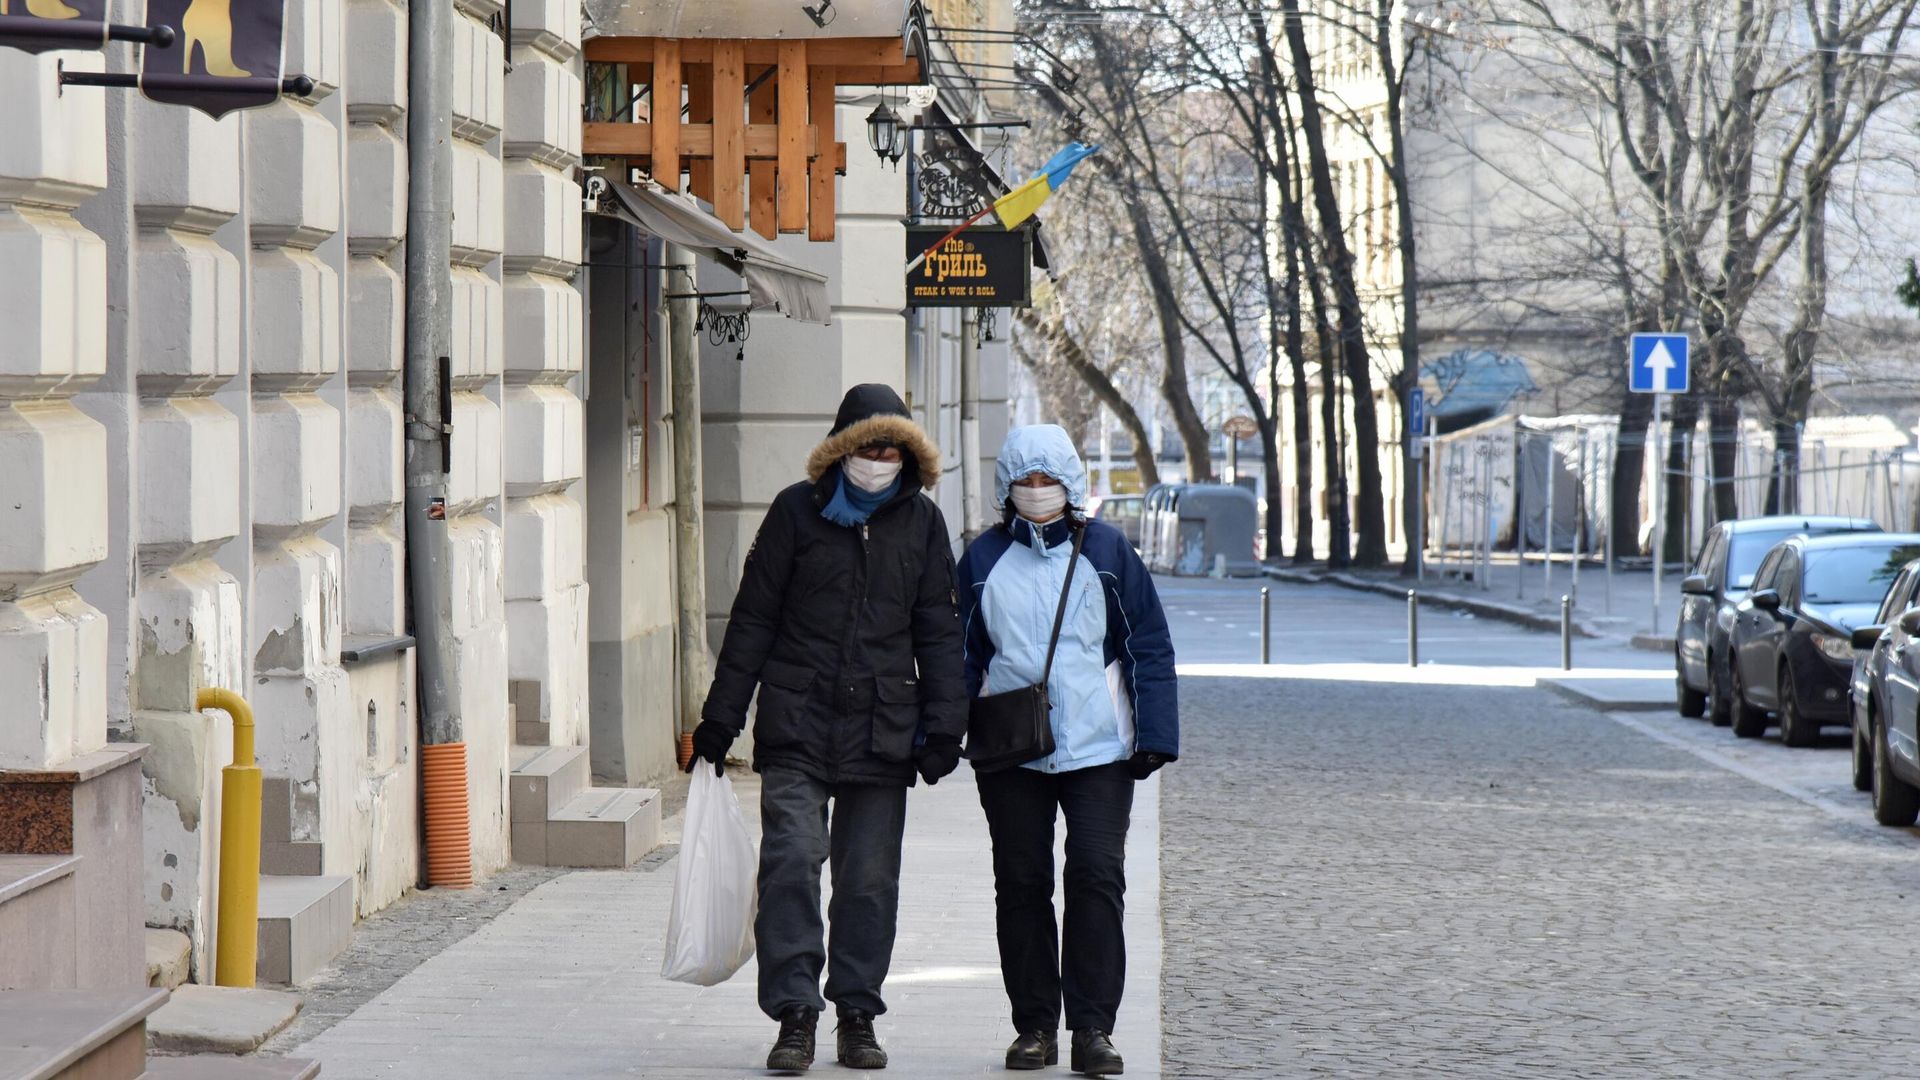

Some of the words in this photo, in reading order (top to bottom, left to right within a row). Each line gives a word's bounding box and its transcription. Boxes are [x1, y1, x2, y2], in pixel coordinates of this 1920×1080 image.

[924, 249, 987, 282] Гриль
[914, 286, 938, 296] STEAK
[948, 286, 966, 296] WOK
[976, 286, 996, 296] ROLL
